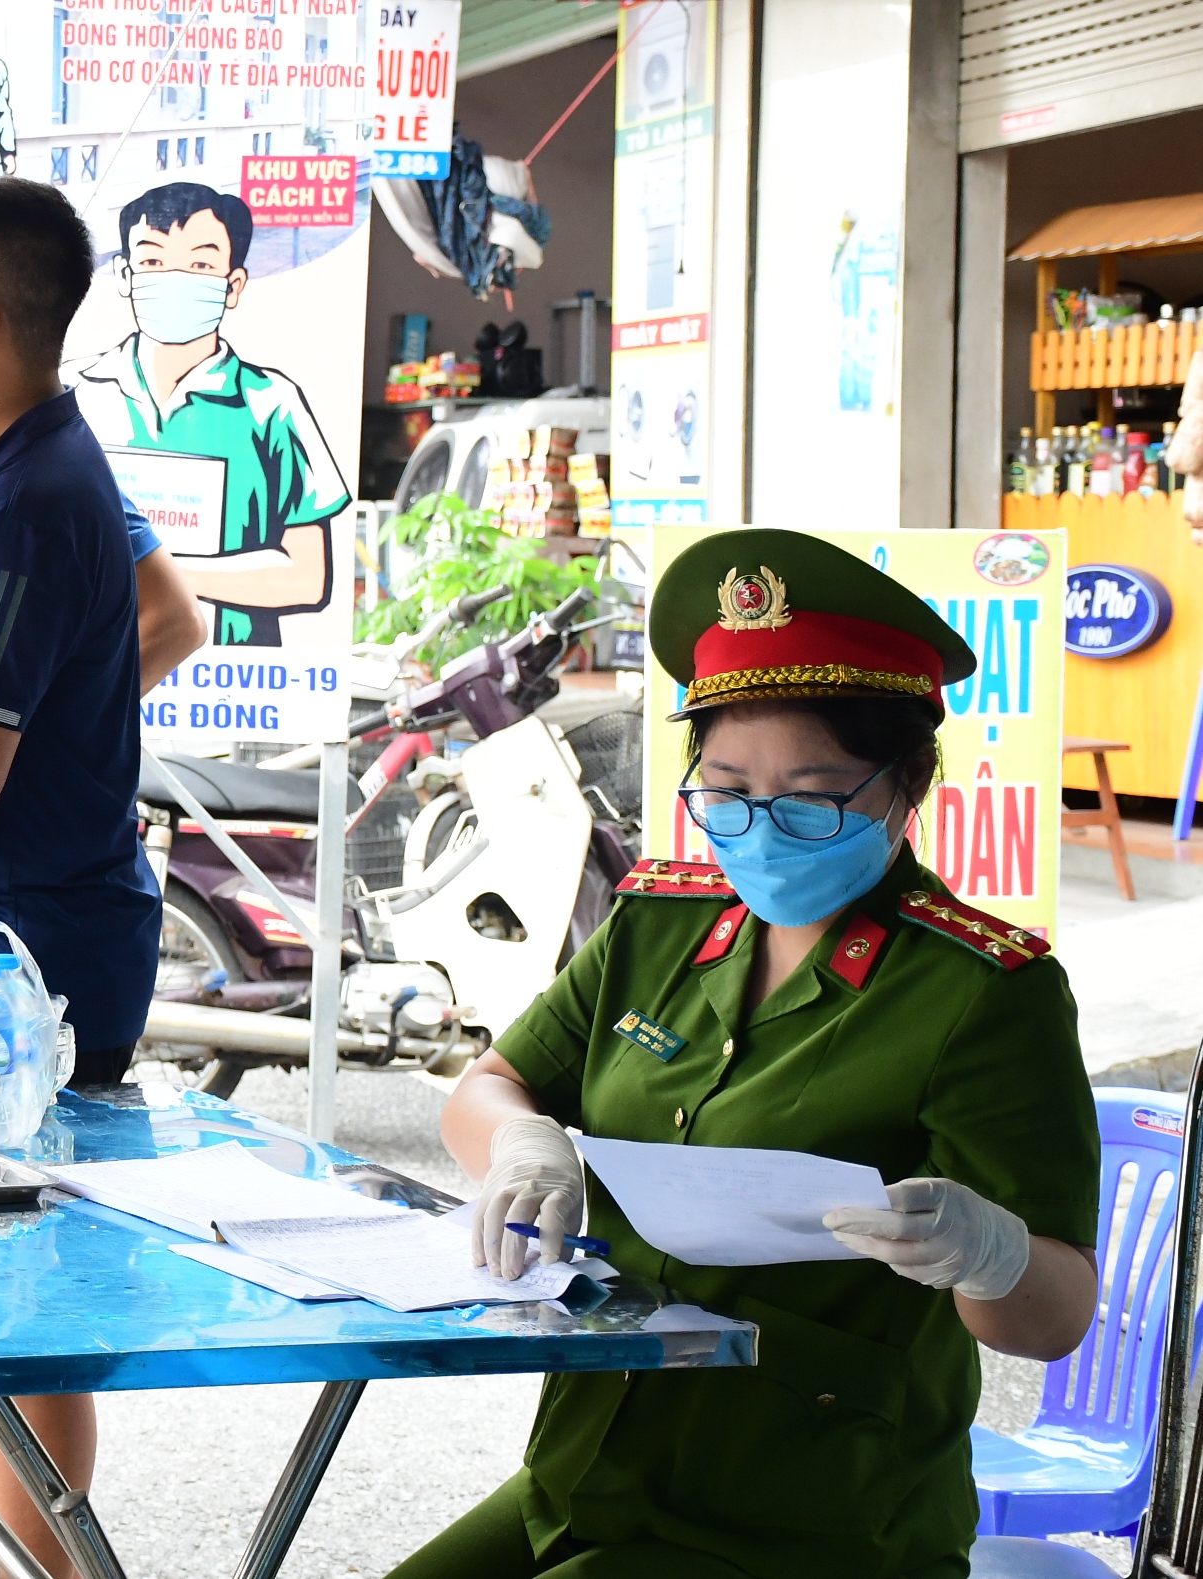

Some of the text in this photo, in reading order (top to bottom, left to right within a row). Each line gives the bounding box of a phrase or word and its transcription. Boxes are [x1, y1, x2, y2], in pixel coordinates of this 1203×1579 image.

[63, 59, 101, 81] CHO
[109, 60, 135, 83] CƠ
[141, 61, 194, 85] QUAN
[202, 63, 212, 84] Y
[287, 64, 365, 88] PHƯƠNG
[409, 32, 450, 98] ĐỐI
[397, 104, 429, 141] LỄ
[247, 159, 351, 184] KHU VỰC
[249, 183, 347, 207] CÁCH LY
[193, 663, 337, 692] COVID-19
[922, 598, 1038, 742] UẠT
[190, 695, 278, 730] ĐỒNG
